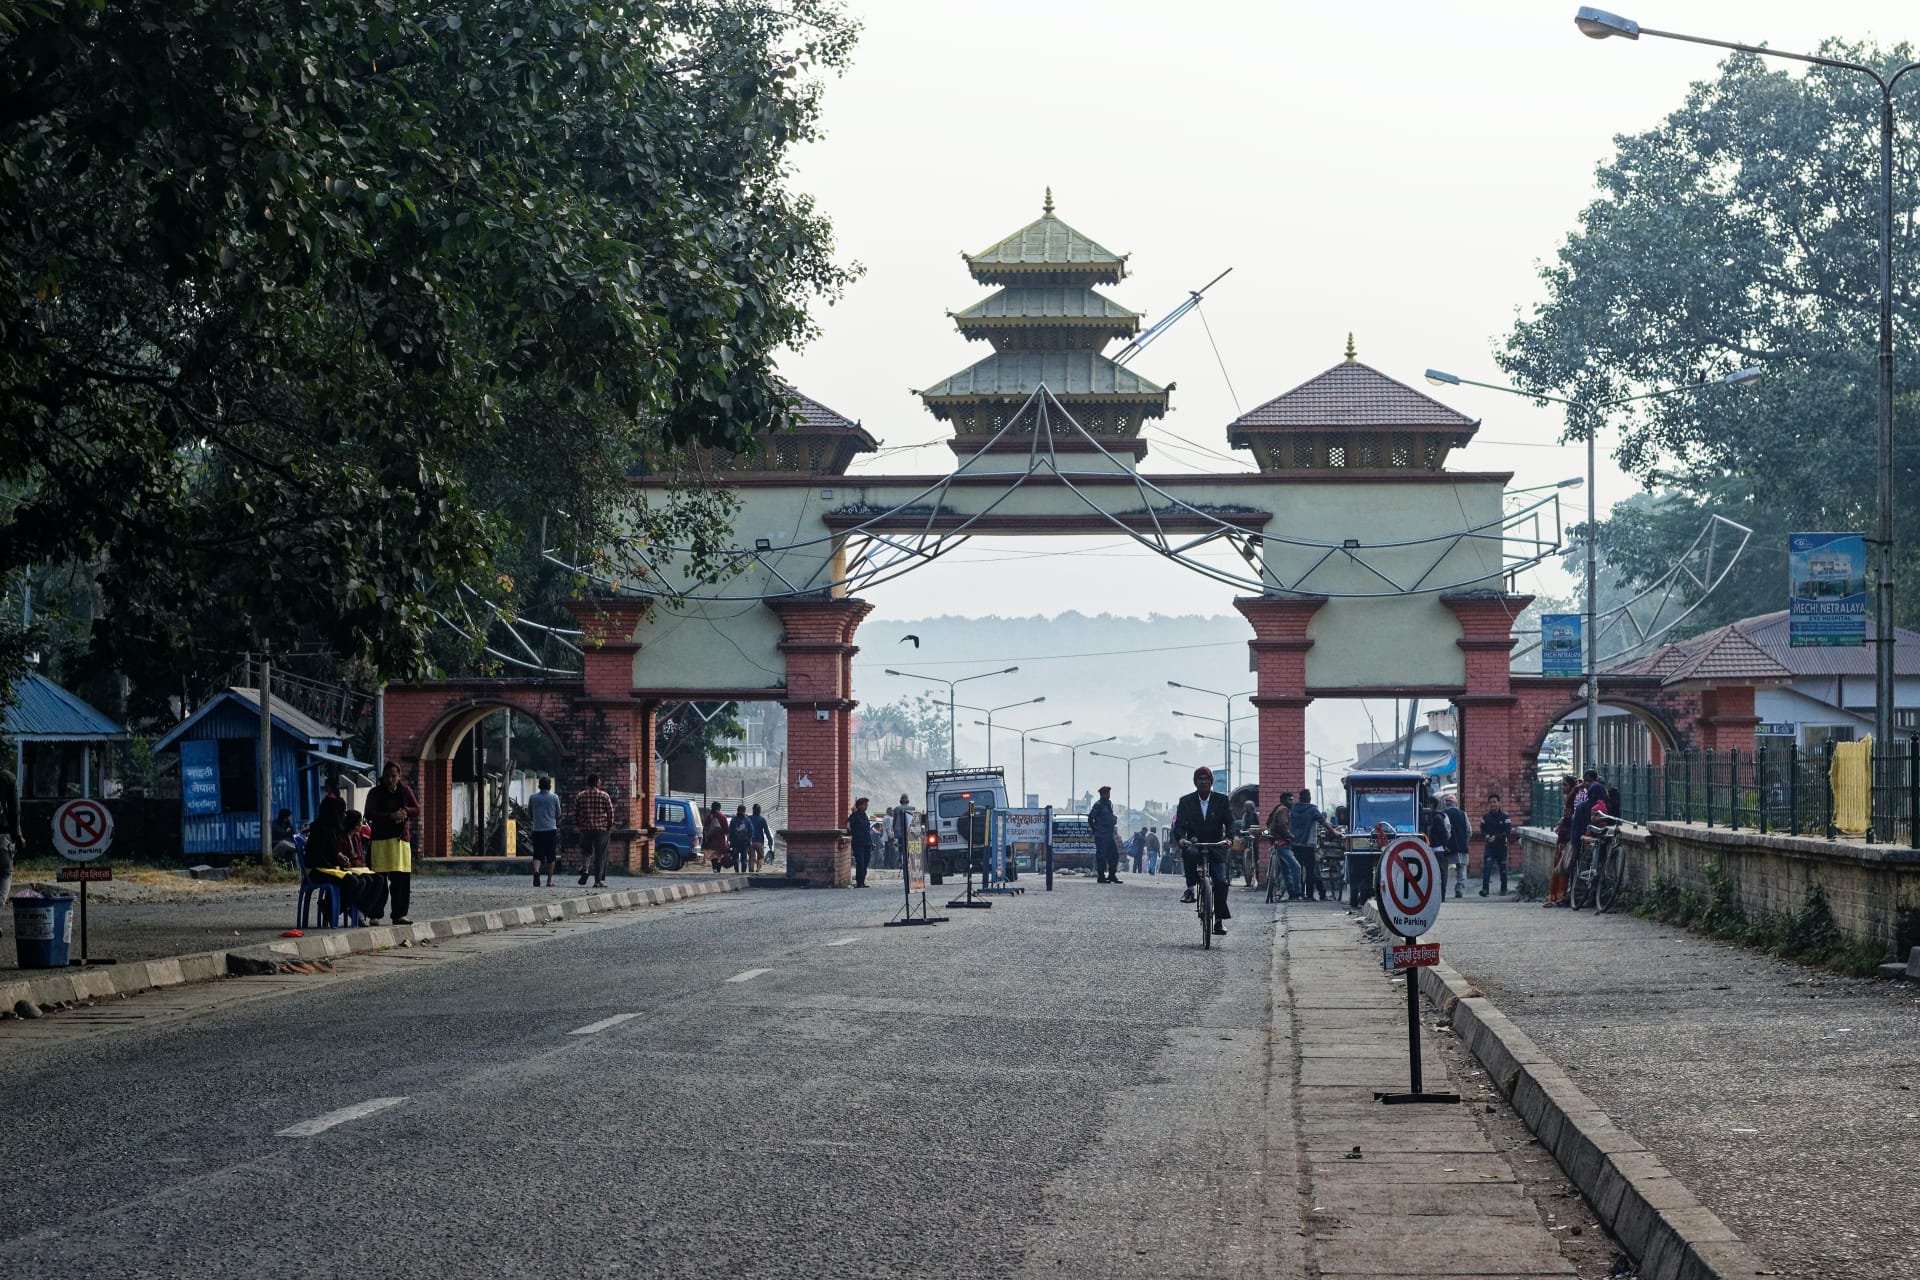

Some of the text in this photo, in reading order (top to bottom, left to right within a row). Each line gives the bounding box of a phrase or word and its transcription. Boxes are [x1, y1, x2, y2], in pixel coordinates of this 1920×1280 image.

[1793, 602, 1866, 614] MECHI NETRALAYA
[191, 781, 217, 793] नेपाल
[184, 823, 226, 841] MAITI
[79, 847, 102, 855] Parking
[1393, 916, 1427, 928] No Parking
